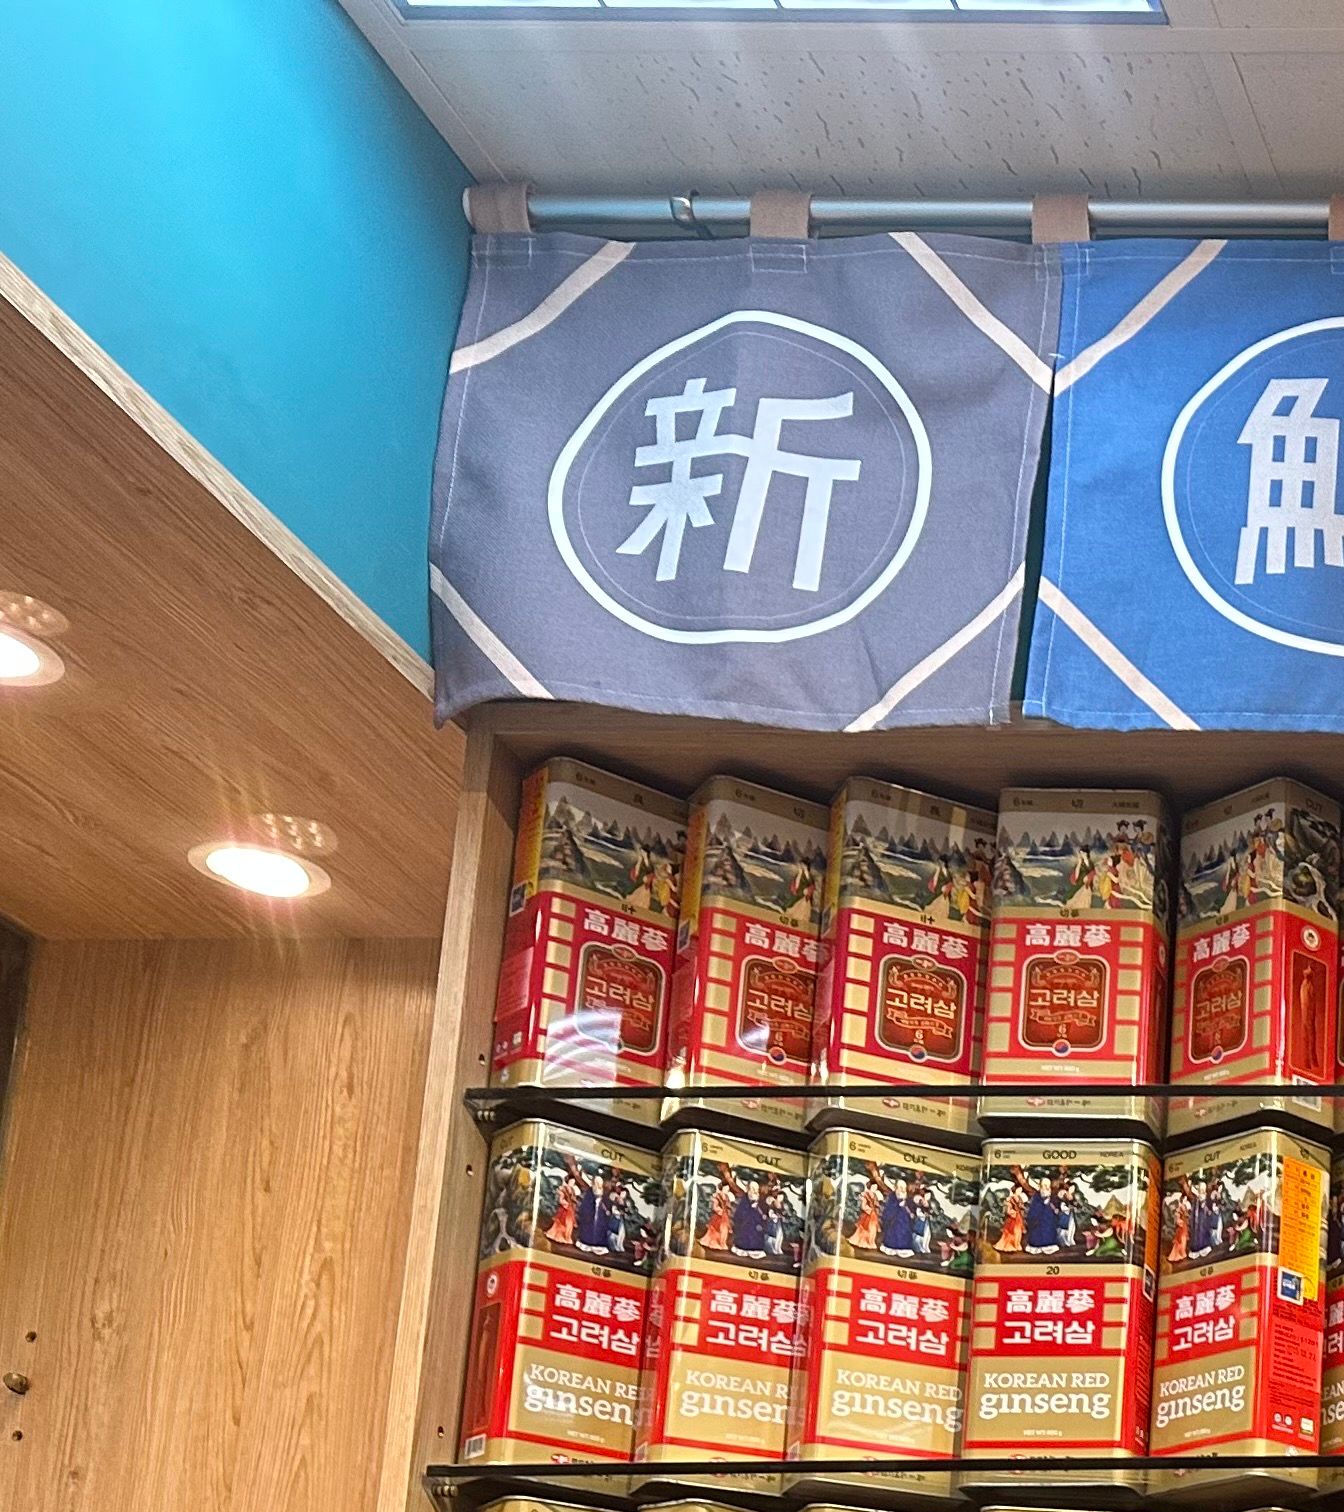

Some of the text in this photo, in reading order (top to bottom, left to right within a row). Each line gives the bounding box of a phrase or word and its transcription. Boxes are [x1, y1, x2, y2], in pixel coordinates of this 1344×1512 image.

[615, 377, 862, 592] 新
[582, 908, 669, 953] 高麗蔘
[882, 921, 969, 959] 高麗蔘
[1025, 923, 1111, 948] 高麗蔘
[584, 976, 655, 1011] 고려삼
[886, 987, 957, 1019] 고려삼
[1029, 988, 1099, 1008] 고려삼
[601, 1148, 624, 1163] CUT
[756, 1153, 780, 1167] CUT
[904, 1153, 928, 1165] CUT
[1042, 1150, 1077, 1160] GOOD
[1203, 1150, 1221, 1163] CUT
[1046, 1266, 1060, 1275] 20
[554, 1283, 641, 1323] 高麗蔘
[859, 1288, 950, 1323] 高麗蔘
[1006, 1288, 1095, 1315] 高麗蔘
[1174, 1283, 1235, 1320] 高麗蔘
[550, 1314, 640, 1356] 고려삼
[856, 1318, 949, 1356] 고려삼
[1002, 1321, 1095, 1346] 고려삼
[1171, 1318, 1235, 1352] 고려삼
[530, 1363, 611, 1396] KOREAN
[685, 1369, 772, 1397] KOREAN
[836, 1369, 962, 1402] KOREAN RED
[984, 1373, 1110, 1389] KOREAN RED
[1159, 1364, 1245, 1396] KOREAN RED
[831, 1389, 963, 1433] ginseng
[979, 1391, 1111, 1420] ginseng
[1155, 1383, 1246, 1428] ginseng
